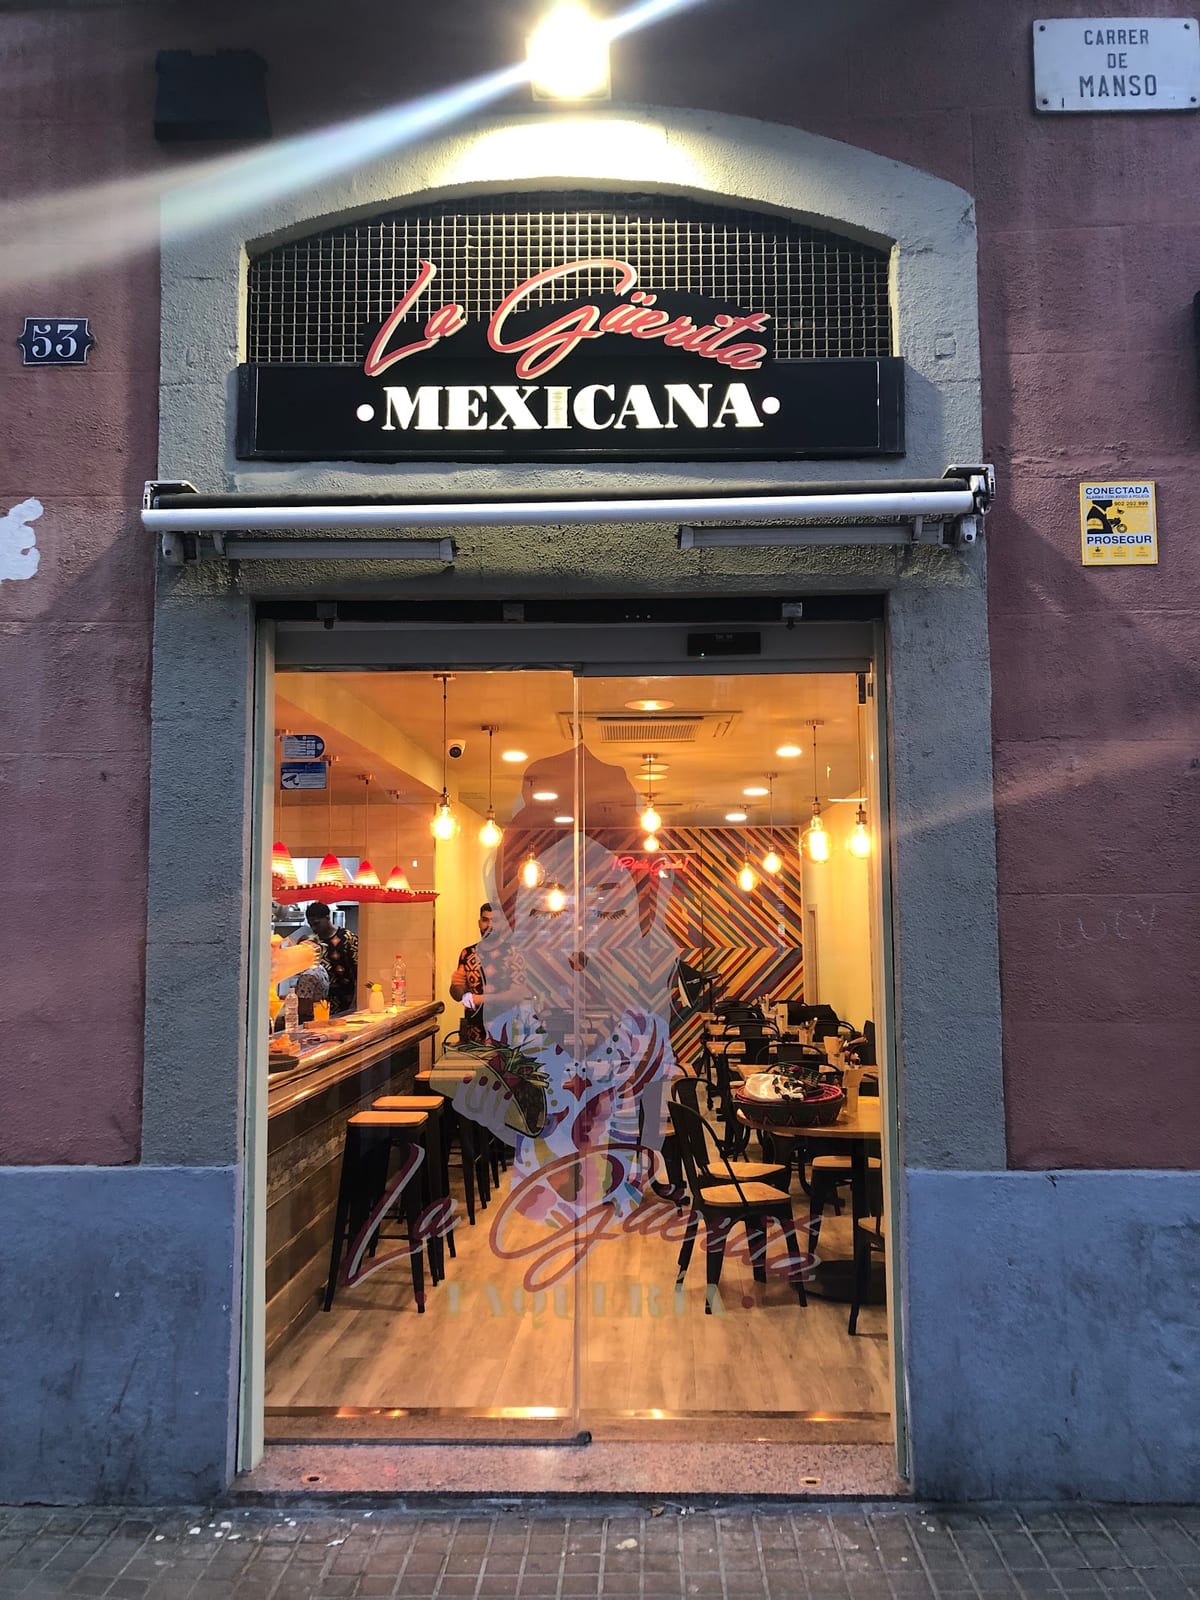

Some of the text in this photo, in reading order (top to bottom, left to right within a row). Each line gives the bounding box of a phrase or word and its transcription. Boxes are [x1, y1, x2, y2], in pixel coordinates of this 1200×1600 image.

[1084, 29, 1149, 45] CARRER
[1107, 52, 1128, 69] DE
[1079, 74, 1157, 97] MANSO
[364, 258, 771, 380] La Güerita
[32, 323, 79, 358] 53
[381, 383, 764, 430] MEXICANA
[1085, 486, 1150, 495] CONECTADA
[1087, 535, 1152, 544] PROSEGUR
[343, 1142, 462, 1288] La
